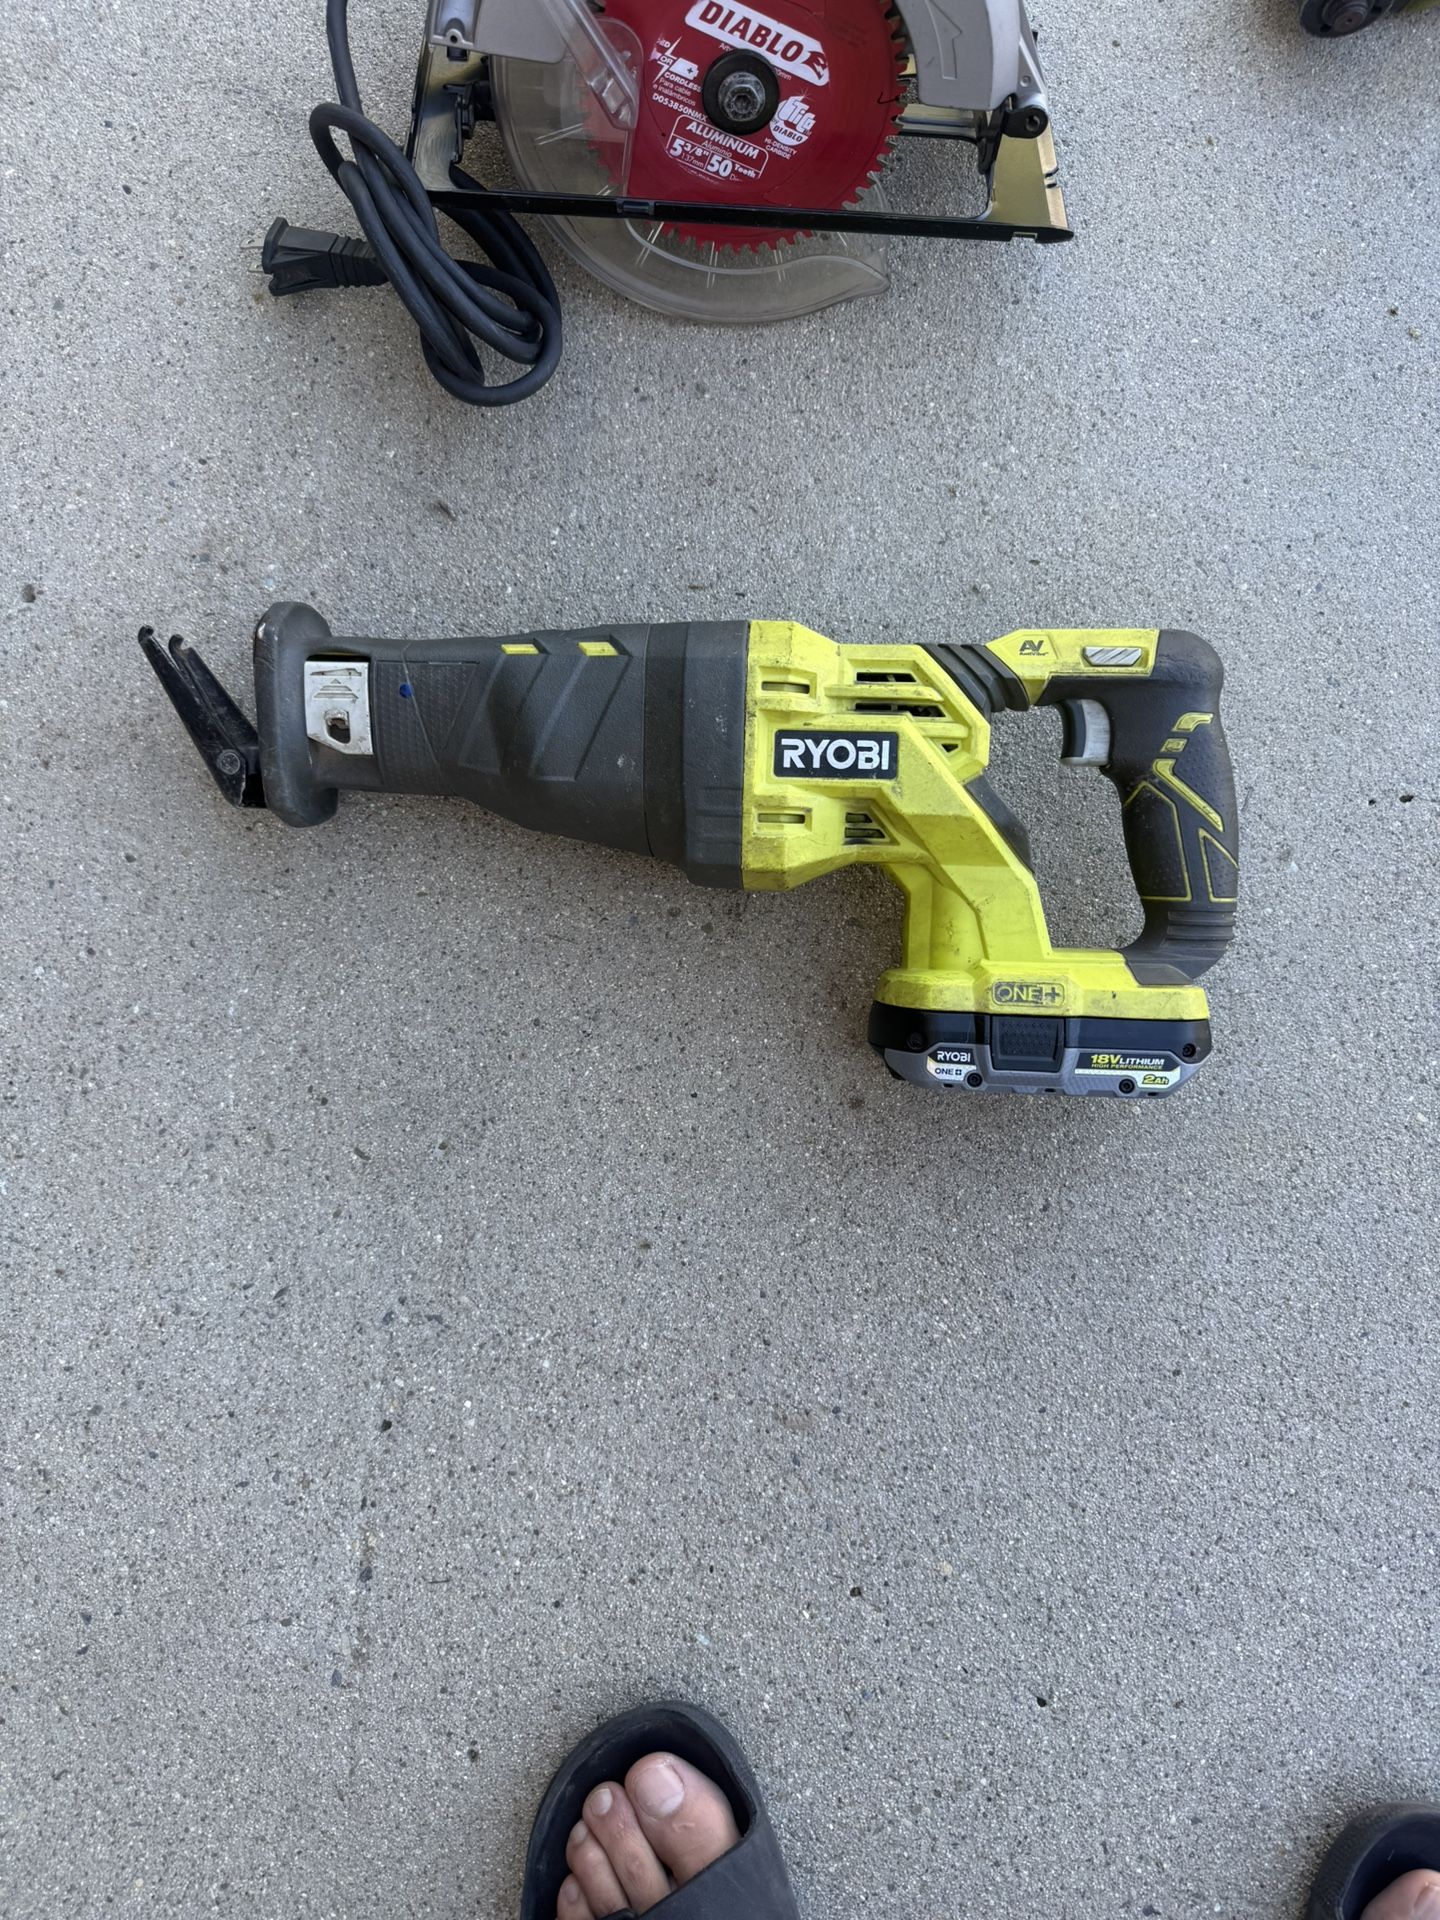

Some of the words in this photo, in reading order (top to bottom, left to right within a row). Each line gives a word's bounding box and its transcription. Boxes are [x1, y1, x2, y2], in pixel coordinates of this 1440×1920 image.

[698, 1, 804, 63] DIABLO
[659, 77, 674, 89] Para
[674, 84, 692, 97] cable
[664, 71, 702, 93] CORDLESS
[686, 121, 760, 159] ALUMINUM
[773, 125, 803, 143] DIABLO
[701, 140, 732, 157] Aluminio
[765, 145, 792, 160] CARBIDE
[706, 154, 733, 177] 50
[734, 163, 757, 178] Teeth
[1019, 639, 1044, 651] AV
[780, 738, 891, 771] RYOBI
[937, 1050, 971, 1062] RYOBI
[1091, 1054, 1121, 1064] 18V
[1119, 1058, 1165, 1066] LITHIUM
[1142, 1073, 1169, 1085] 2Ah
